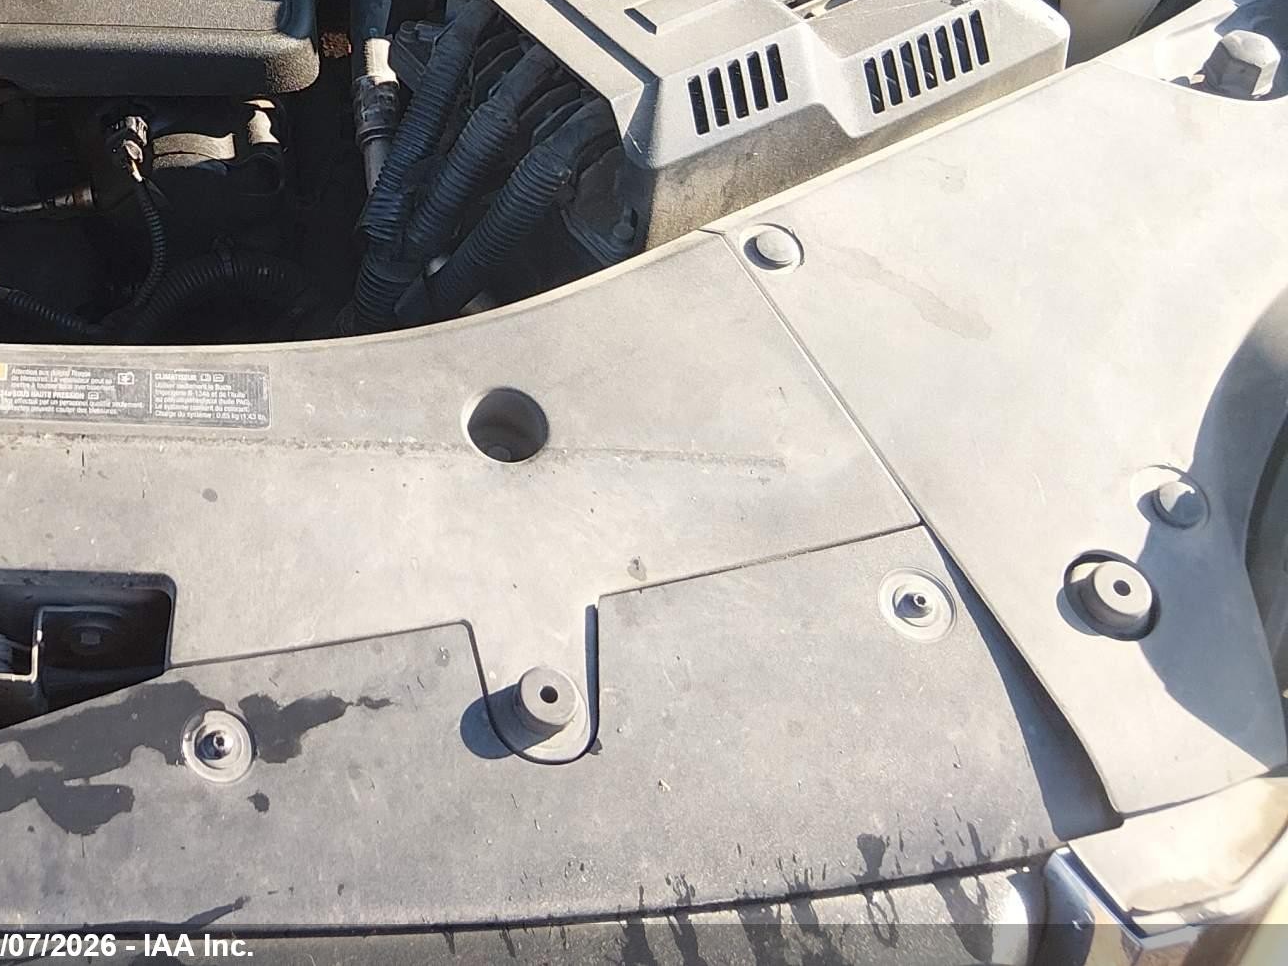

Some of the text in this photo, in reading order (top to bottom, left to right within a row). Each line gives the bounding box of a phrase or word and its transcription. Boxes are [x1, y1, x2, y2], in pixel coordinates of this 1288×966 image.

[154, 373, 197, 381] CLIMATISEUR
[30, 390, 52, 398] HAUTE
[52, 391, 85, 400] PRESSION
